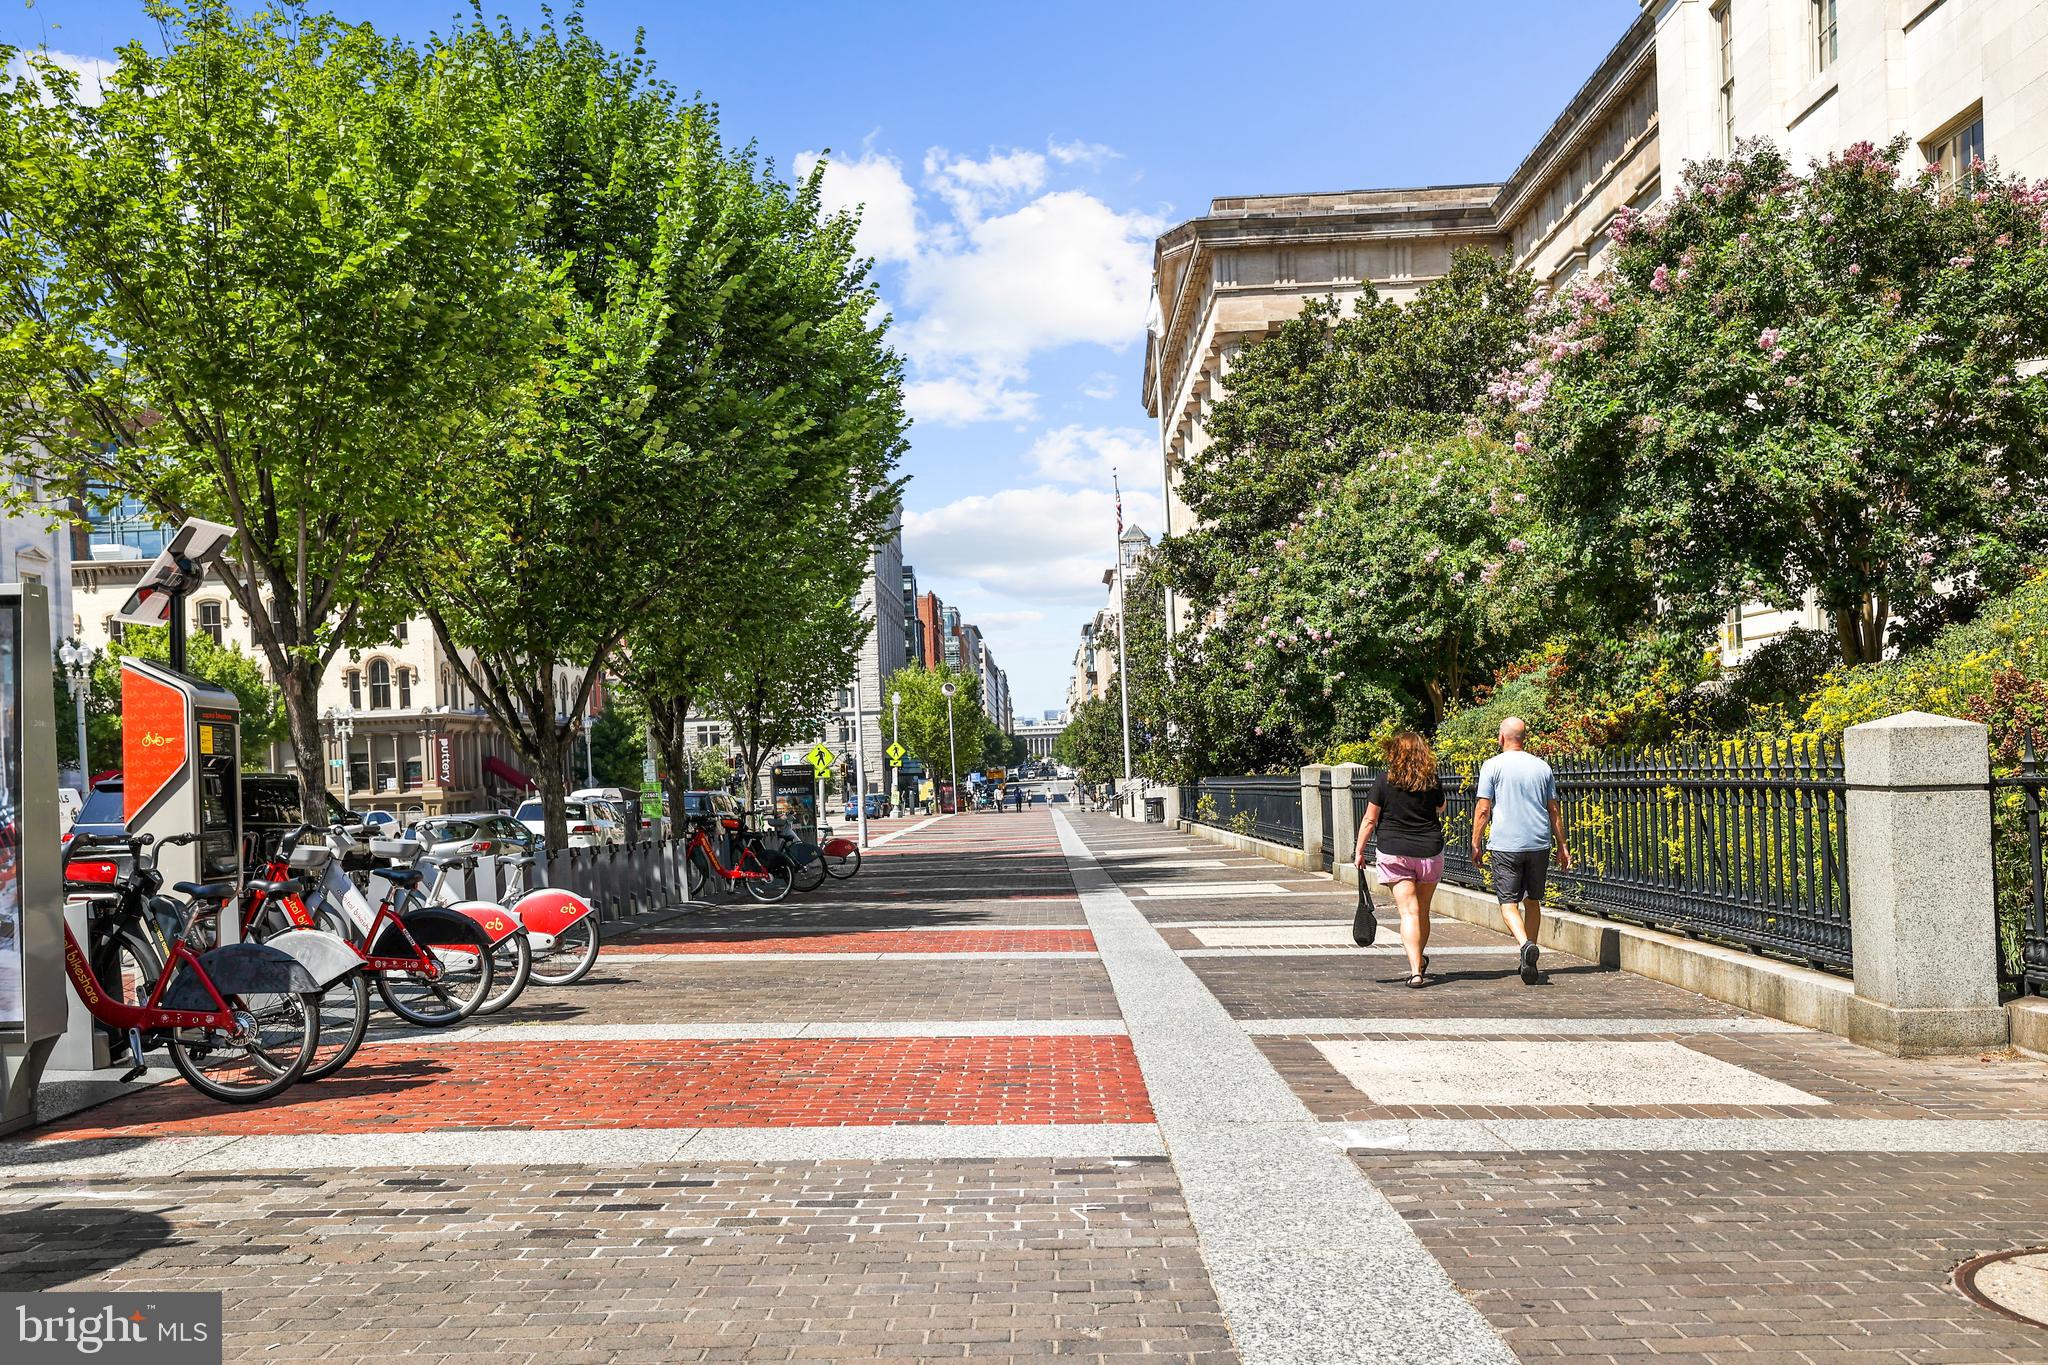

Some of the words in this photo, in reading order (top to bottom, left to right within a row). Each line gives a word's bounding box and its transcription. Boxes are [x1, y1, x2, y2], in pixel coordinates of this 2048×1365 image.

[438, 738, 450, 783] puttery
[783, 754, 791, 764] P
[778, 787, 798, 795] SAAM
[626, 801, 632, 810] P
[66, 950, 99, 1005] bikeshare
